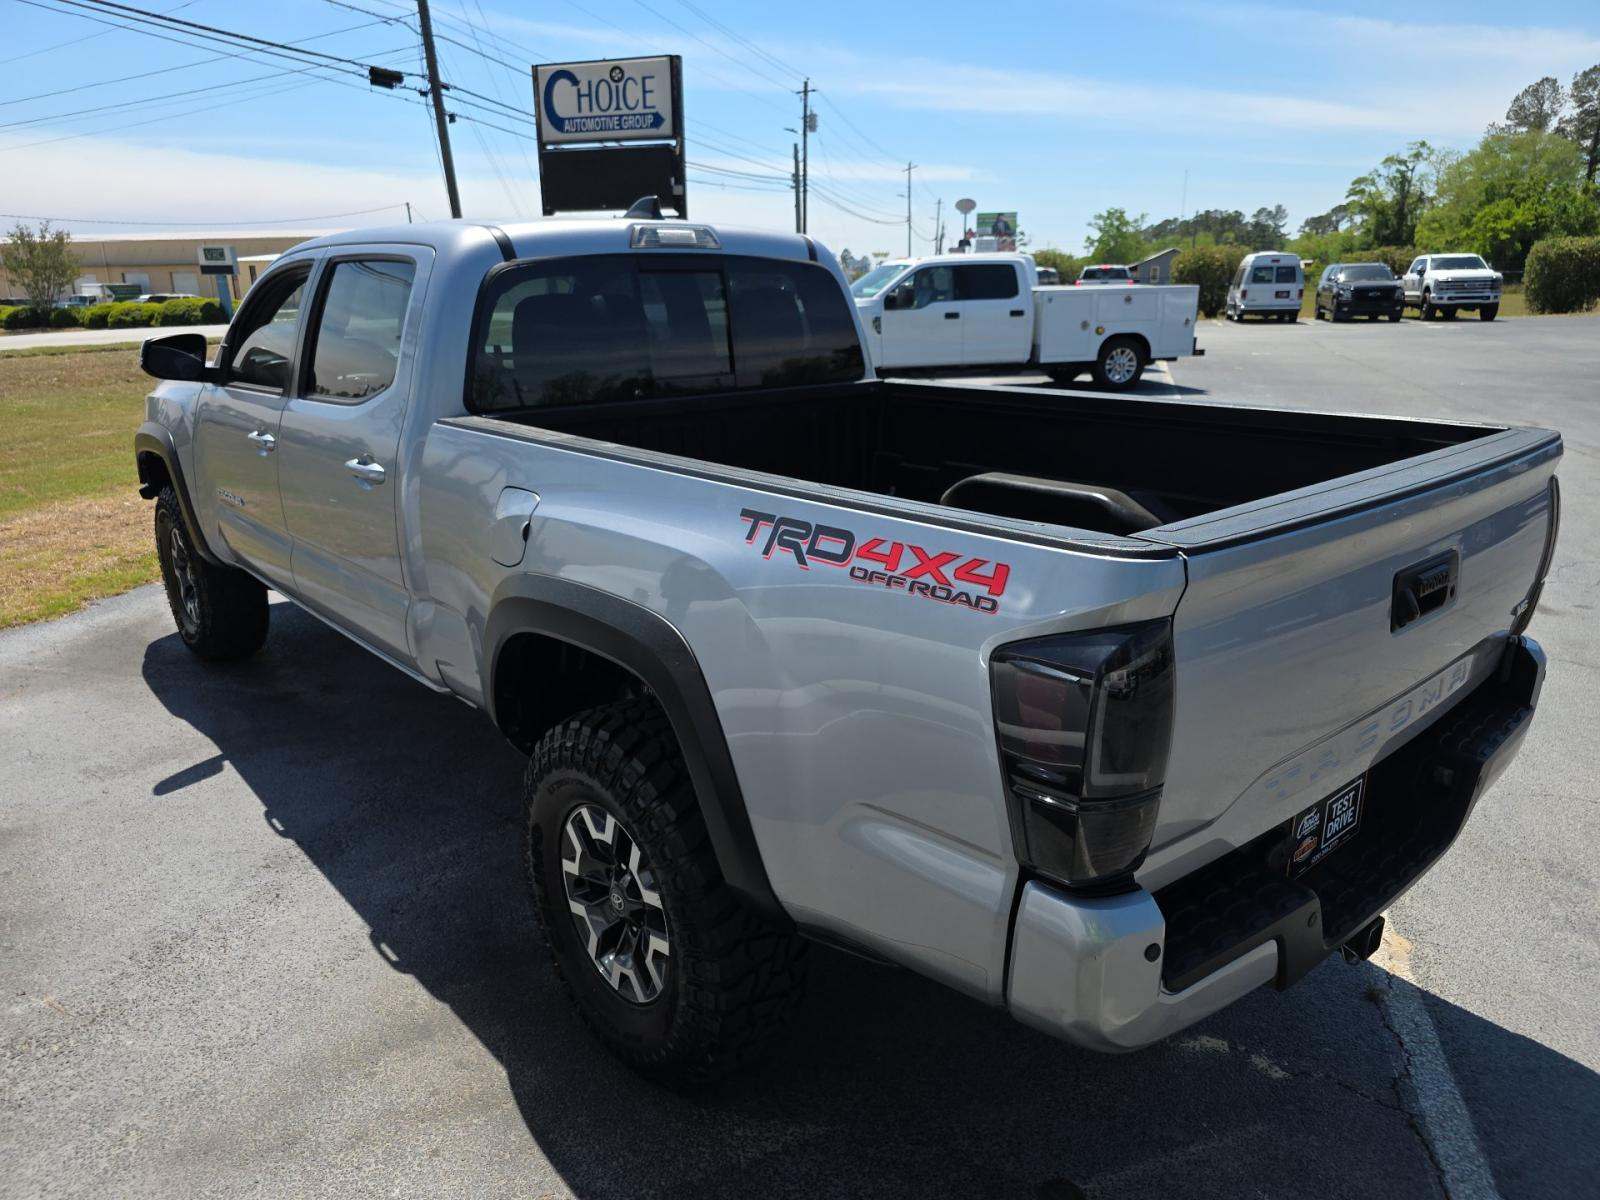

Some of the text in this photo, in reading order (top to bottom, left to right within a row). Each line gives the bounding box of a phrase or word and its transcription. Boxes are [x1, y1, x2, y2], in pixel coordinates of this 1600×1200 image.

[564, 115, 654, 132] AUTOMOTIVE GROUP
[740, 507, 857, 571] TRD
[849, 565, 1000, 615] OFF ROAD
[1332, 790, 1356, 819] TEST
[1326, 806, 1355, 839] DRIVE
